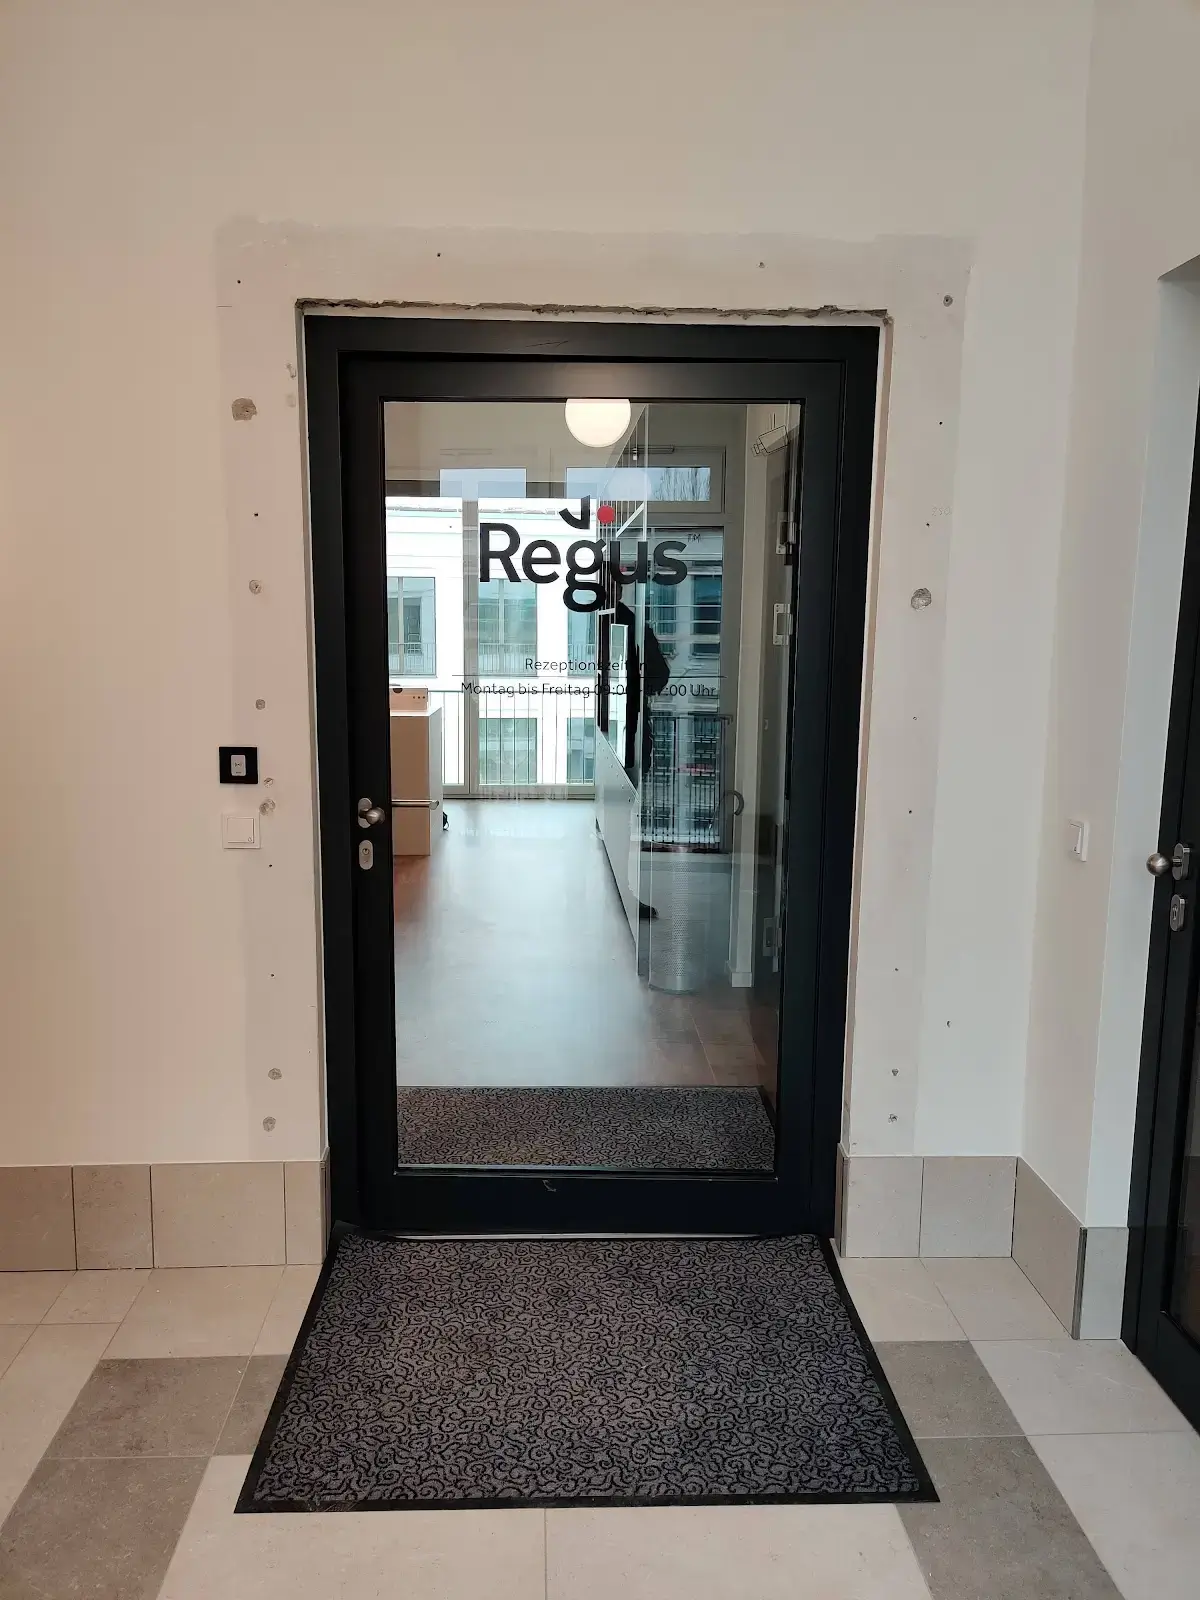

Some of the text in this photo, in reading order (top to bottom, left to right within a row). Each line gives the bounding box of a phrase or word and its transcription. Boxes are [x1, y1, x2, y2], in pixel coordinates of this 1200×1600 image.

[479, 522, 688, 613] Regus
[461, 682, 515, 698] Montag
[518, 682, 538, 695] bis
[542, 682, 590, 698] Freitag
[690, 683, 717, 697] Uhr
